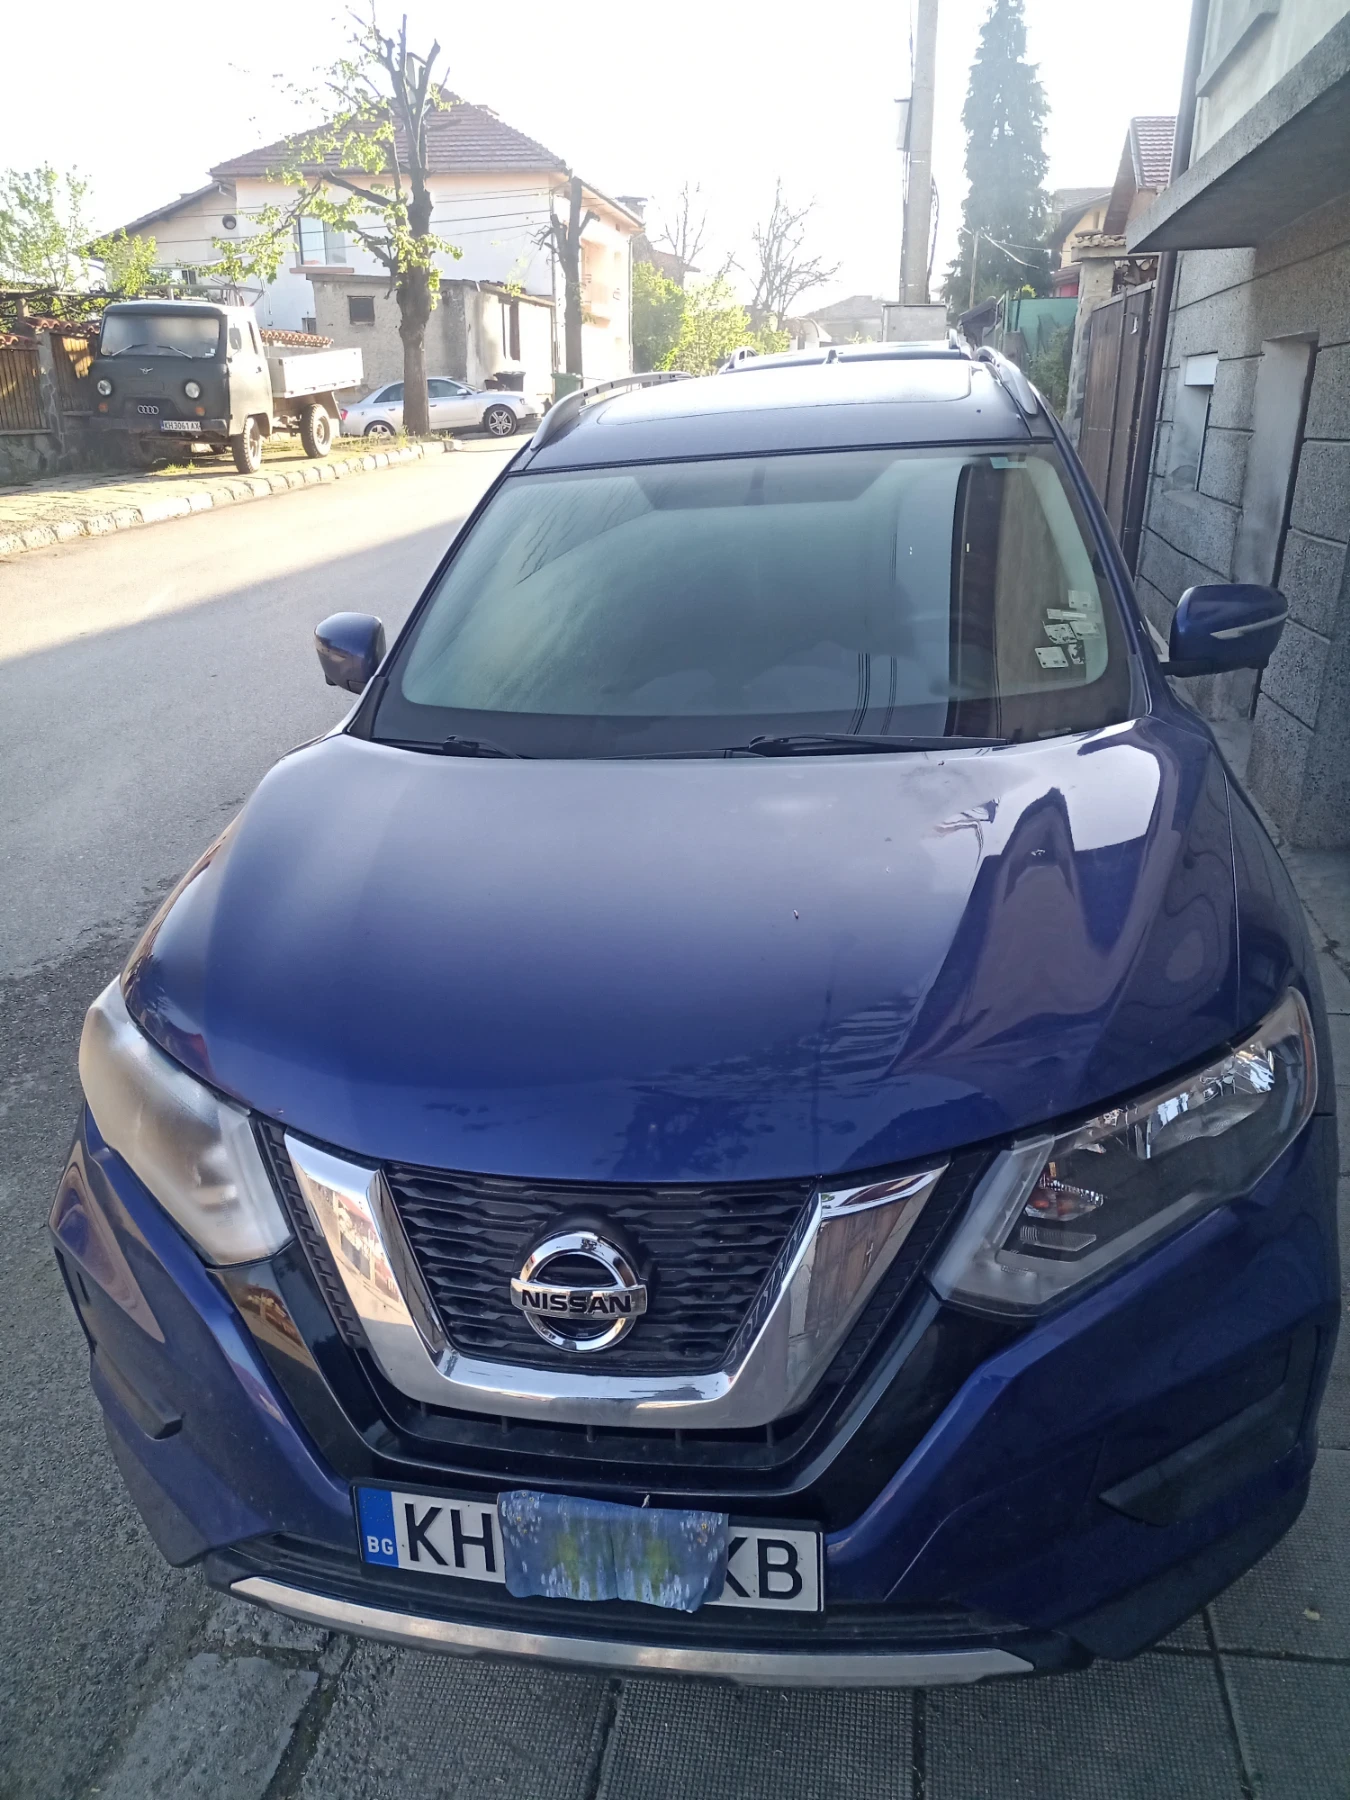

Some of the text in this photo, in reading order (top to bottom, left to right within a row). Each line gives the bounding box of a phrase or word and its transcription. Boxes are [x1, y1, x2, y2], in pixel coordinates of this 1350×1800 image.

[521, 1289, 632, 1314] NISSAN
[366, 1535, 394, 1556] BG
[404, 1502, 497, 1573] KH
